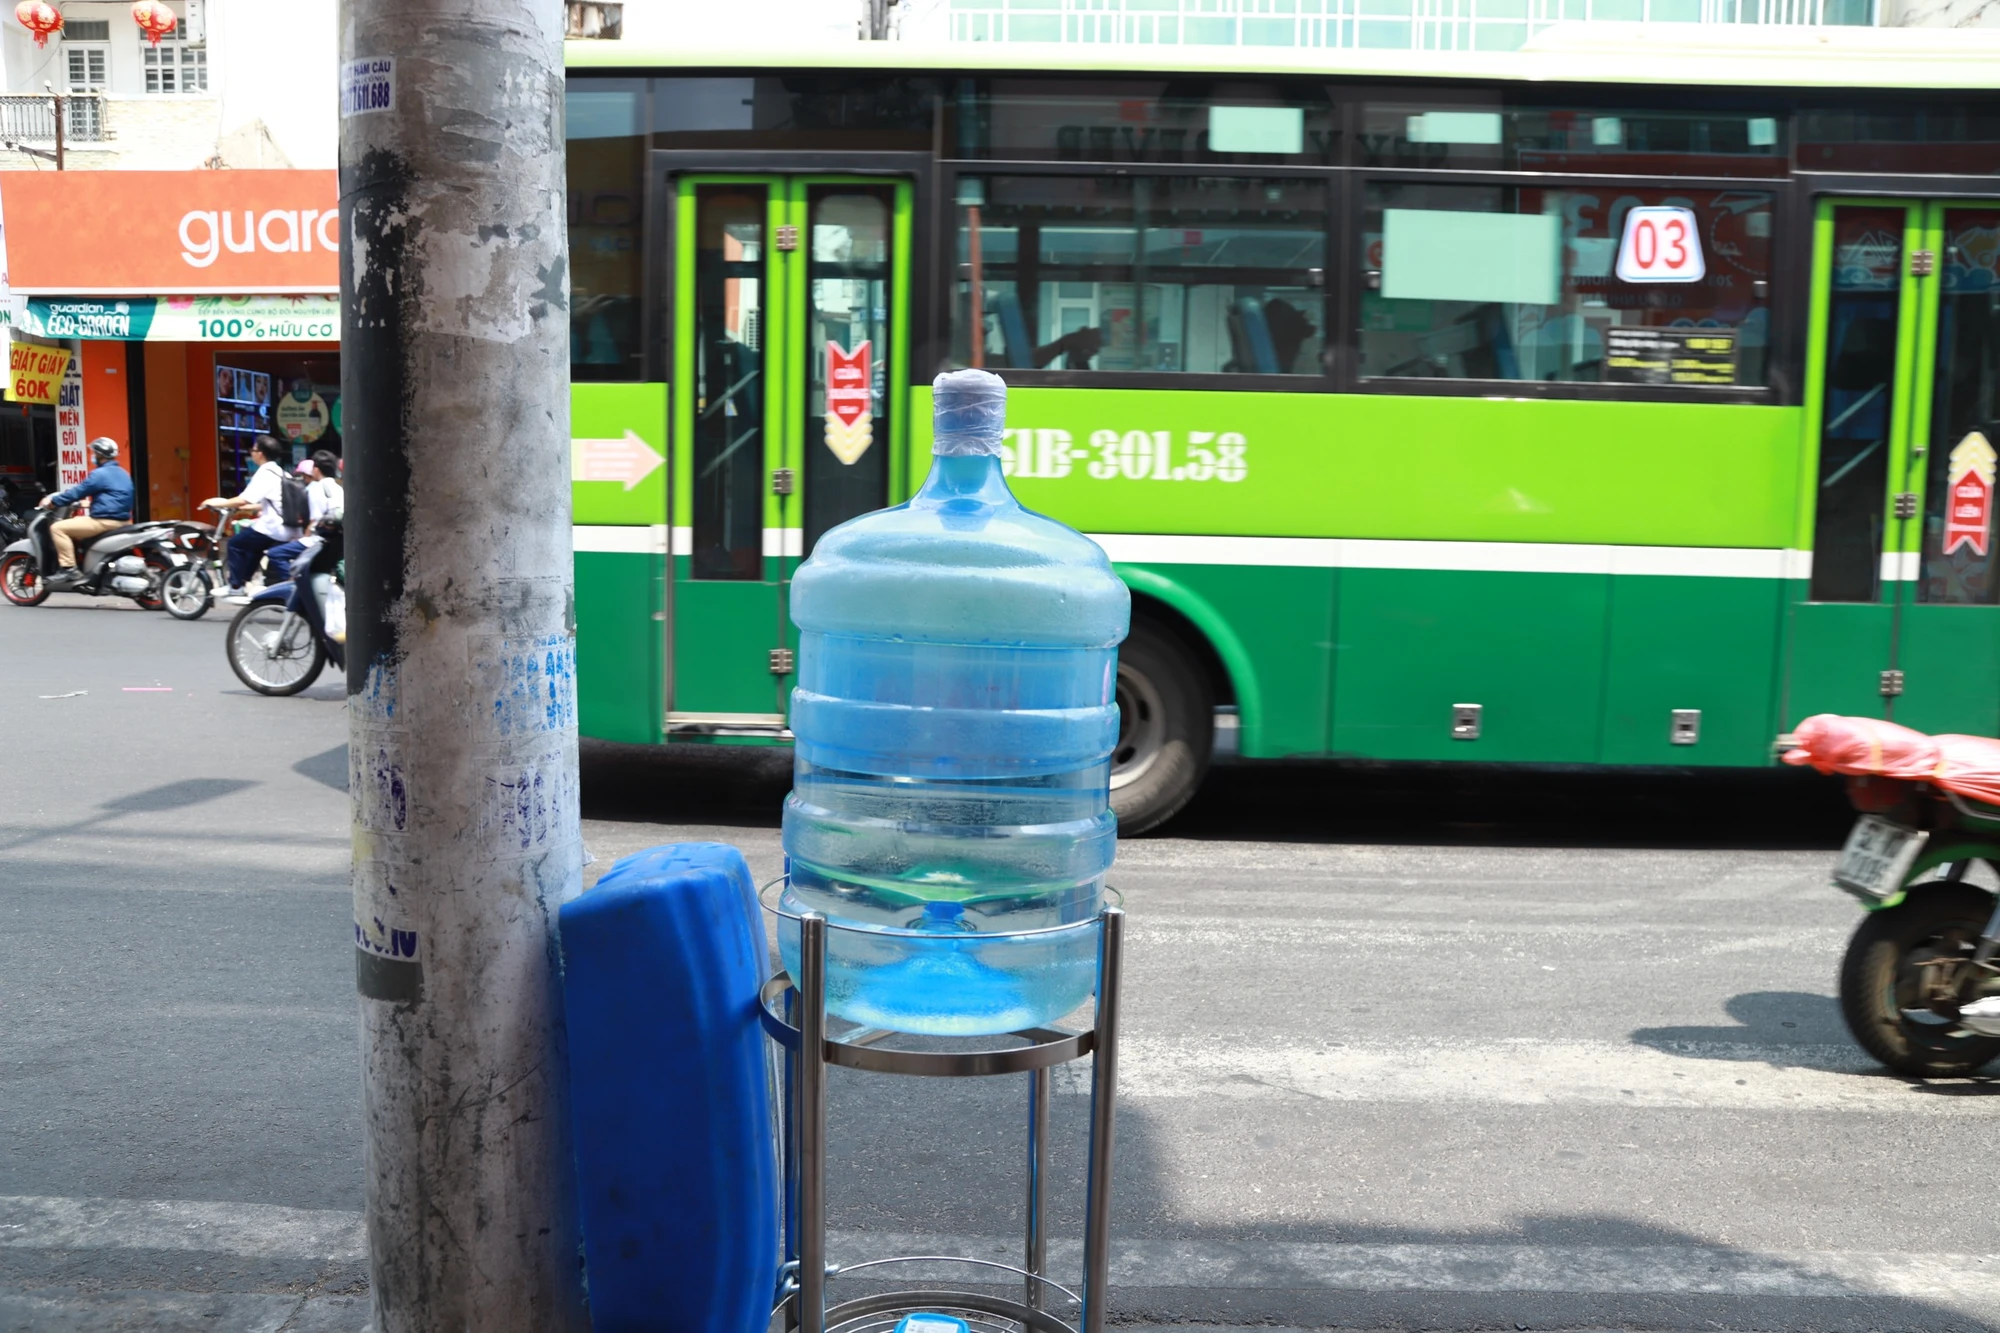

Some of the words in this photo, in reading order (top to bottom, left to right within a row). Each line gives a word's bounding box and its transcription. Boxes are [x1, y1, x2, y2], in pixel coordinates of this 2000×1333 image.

[1634, 219, 1688, 269] 03
[49, 303, 104, 315] guardian
[47, 314, 130, 337] ECO-GARDEN
[199, 319, 265, 338] 100%
[269, 320, 303, 337] HỮU
[307, 323, 333, 337] CƠ
[15, 378, 51, 399] 60K
